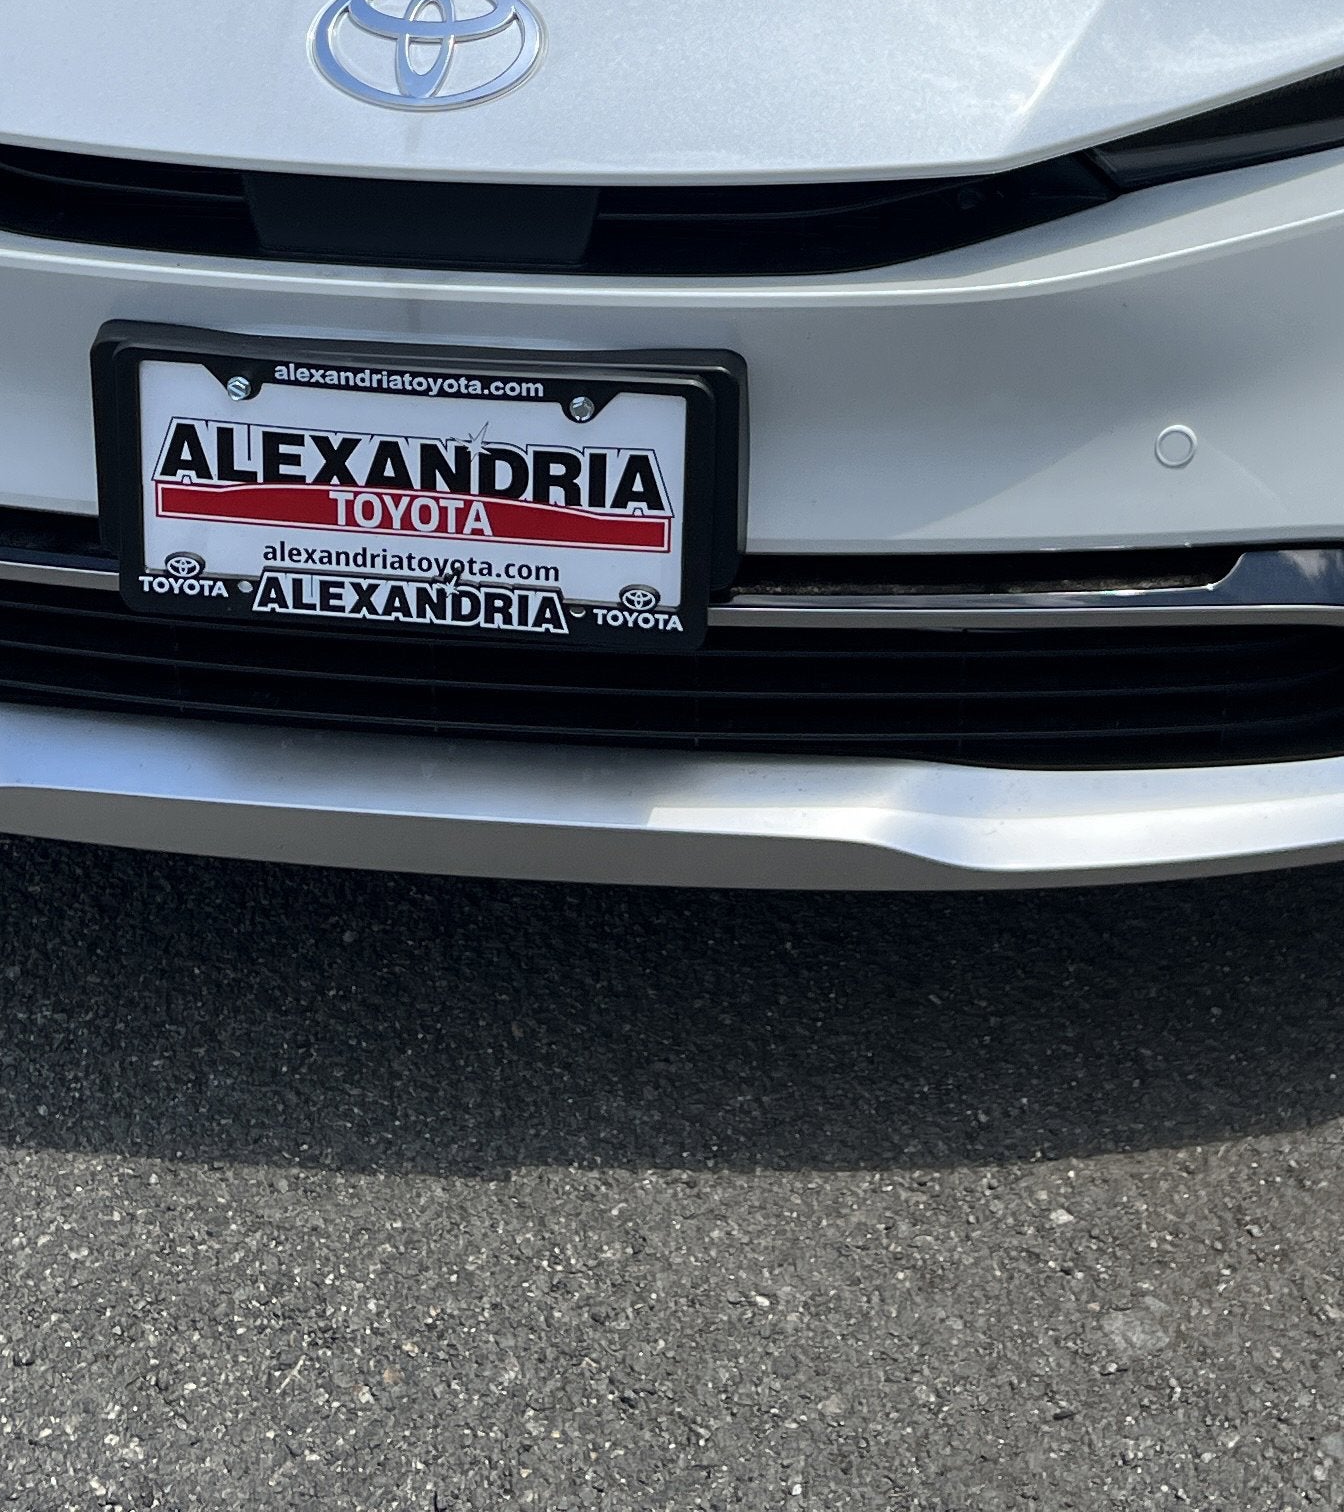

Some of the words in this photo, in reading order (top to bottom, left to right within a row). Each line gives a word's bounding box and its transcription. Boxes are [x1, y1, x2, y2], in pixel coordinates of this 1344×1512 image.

[273, 363, 545, 397] alexandriatoyota.com
[158, 420, 667, 512] ALEXANDRIA
[328, 490, 494, 537] TOYOTA
[262, 540, 560, 582] alexandriatoyota.com
[138, 575, 229, 598] TOYOTA
[254, 573, 568, 633] ALEXANDRIA
[593, 608, 684, 632] TOYOTA
